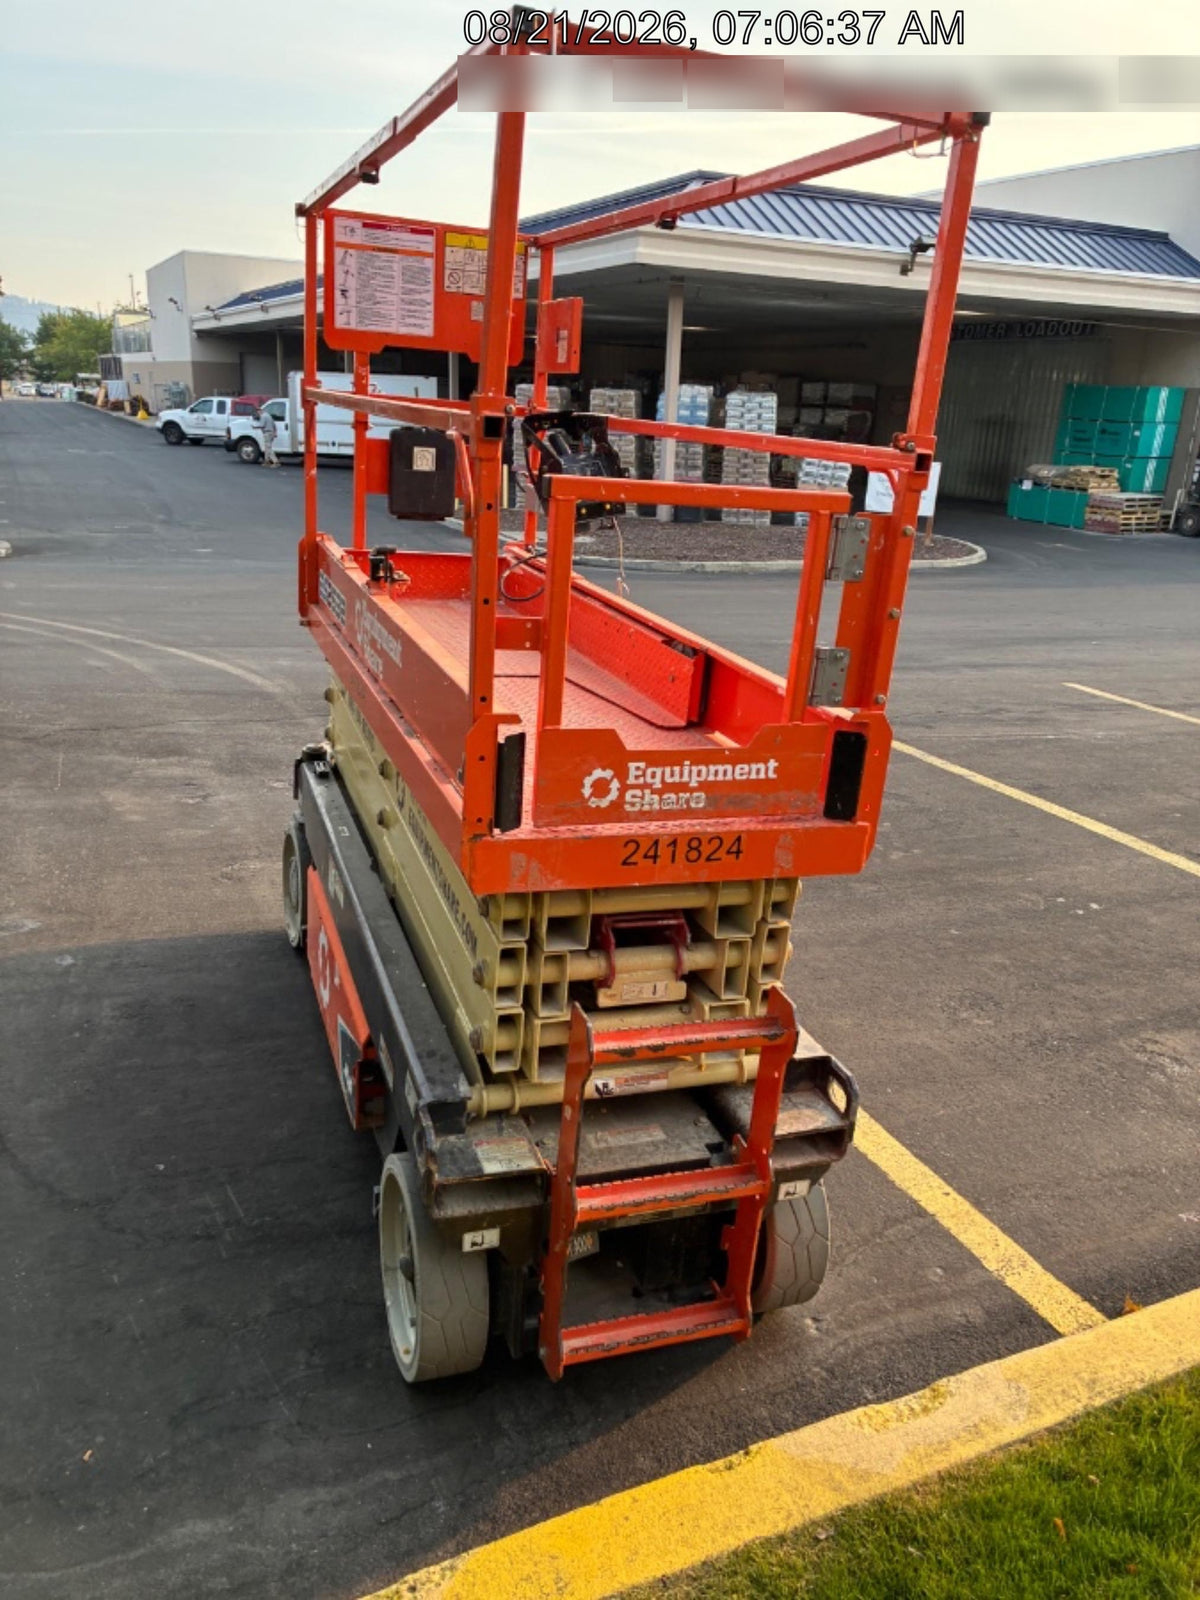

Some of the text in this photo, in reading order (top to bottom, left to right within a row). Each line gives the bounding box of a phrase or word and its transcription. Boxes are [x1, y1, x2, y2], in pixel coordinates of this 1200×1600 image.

[1015, 319, 1096, 337] LOADOUT
[626, 758, 779, 788] Equipment
[624, 789, 707, 812] Share
[620, 834, 744, 867] 241824
